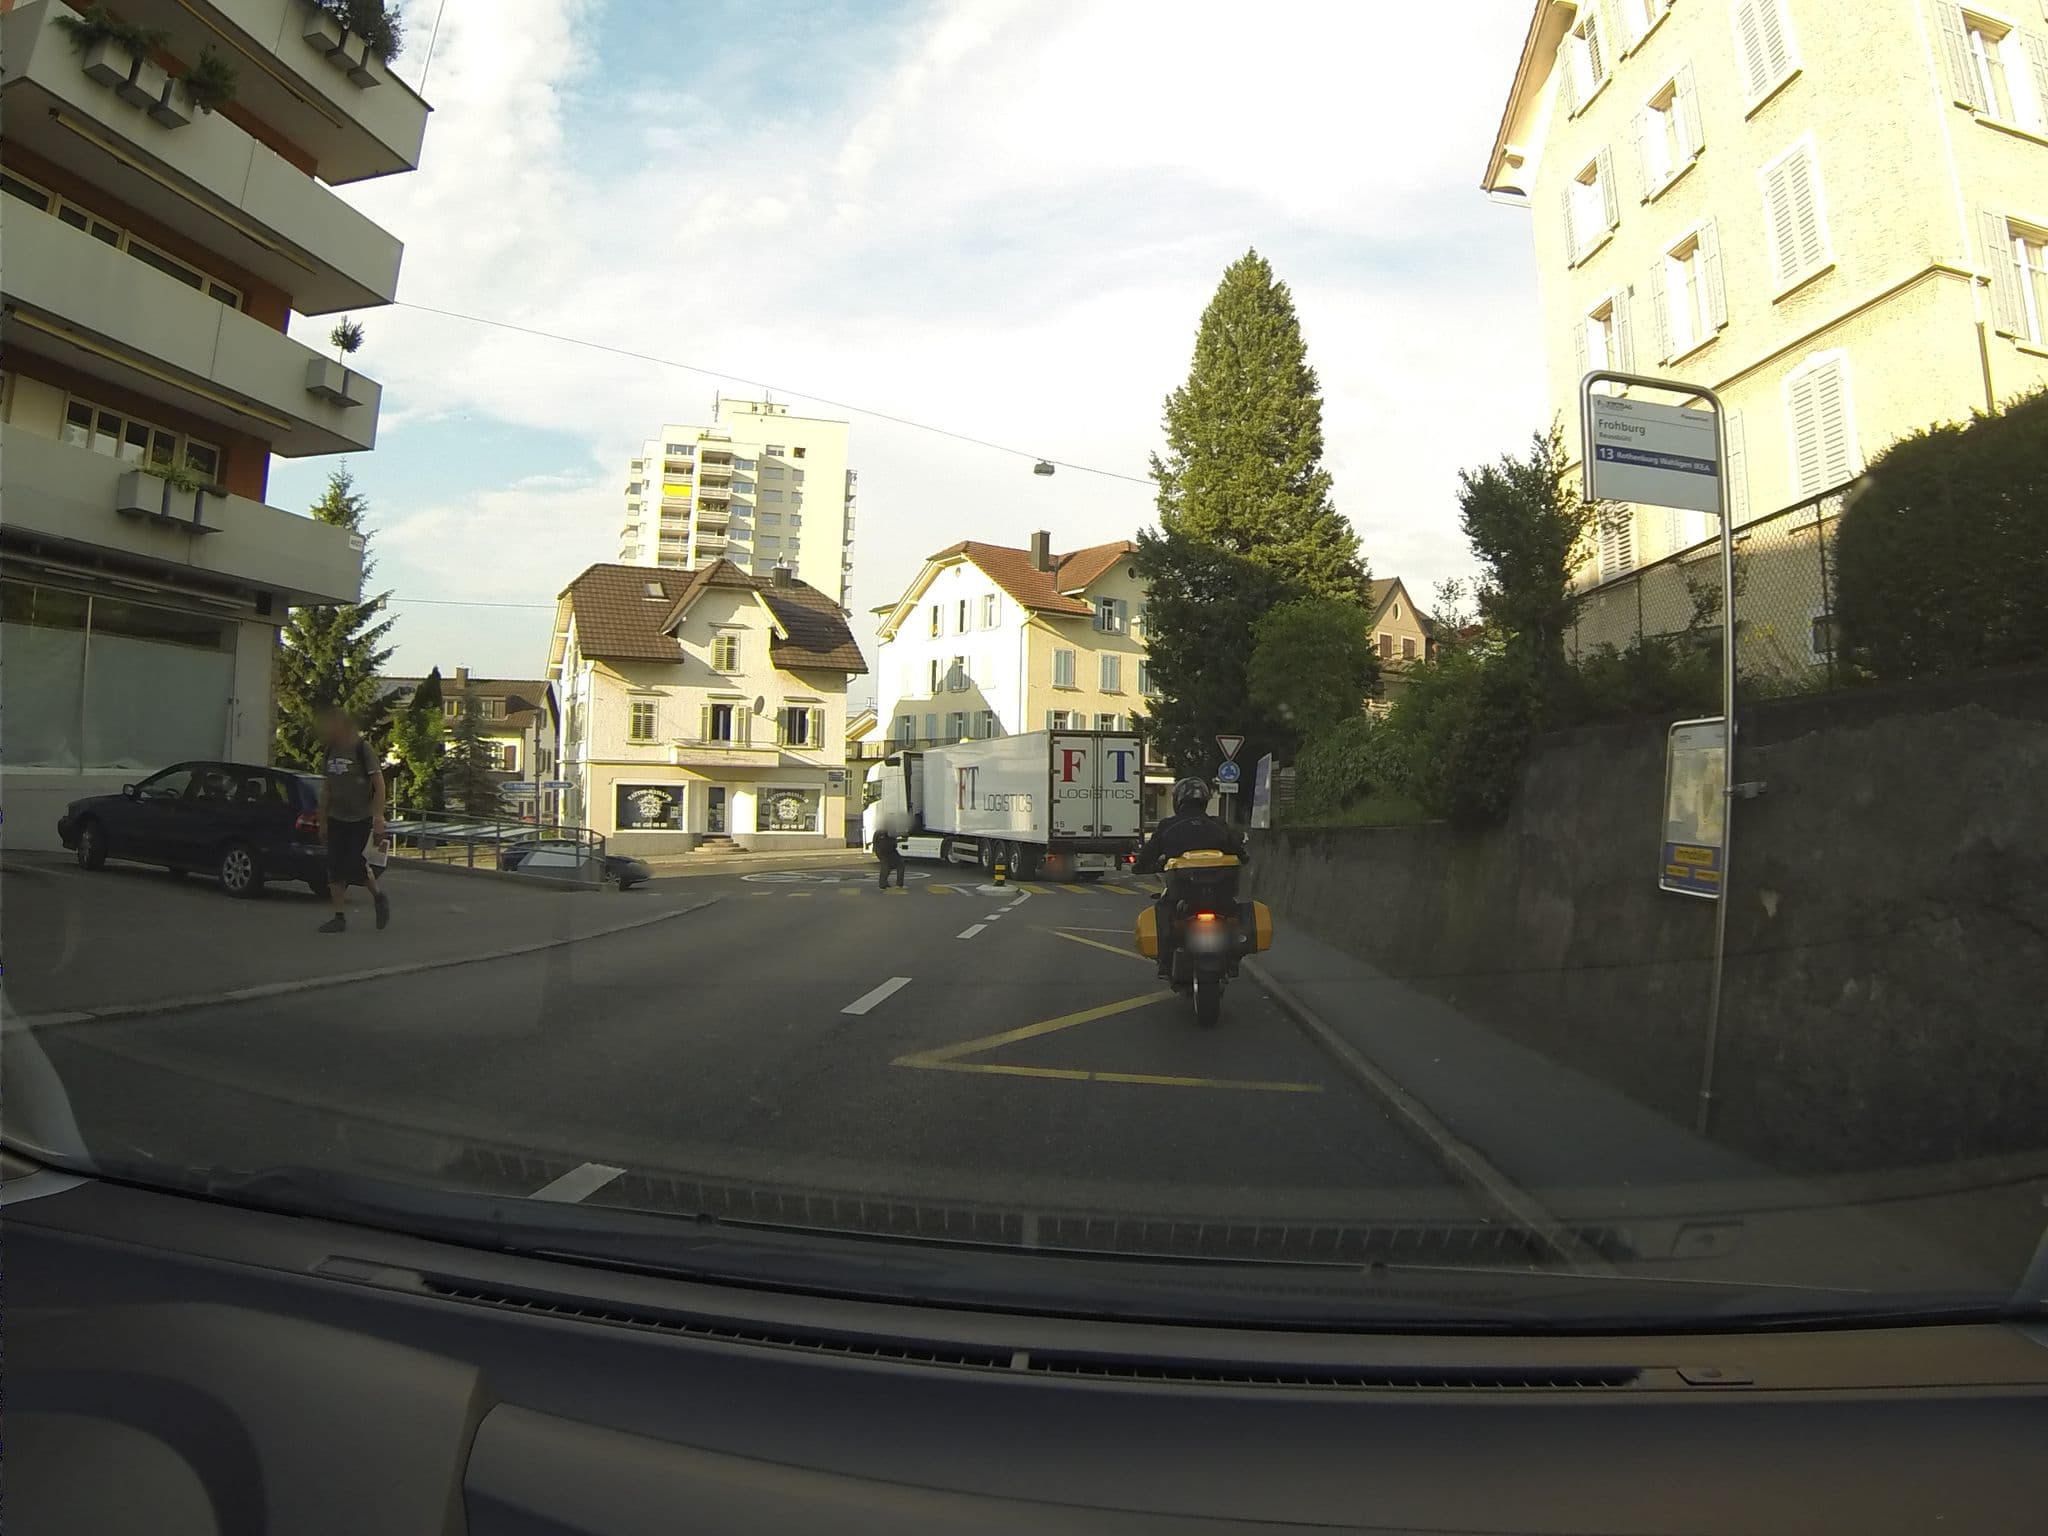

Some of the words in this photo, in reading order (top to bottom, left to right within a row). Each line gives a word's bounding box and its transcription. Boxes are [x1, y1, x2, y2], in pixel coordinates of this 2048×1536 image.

[1598, 419, 1646, 436] Frohburg
[1600, 448, 1614, 460] 13
[1616, 452, 1658, 465] Rothenburg
[1693, 462, 1711, 472] IKEA
[958, 766, 980, 810] FT
[1058, 788, 1135, 800] LOGISTICS
[983, 793, 1033, 813] LOGISTICS
[1055, 820, 1065, 828] 15
